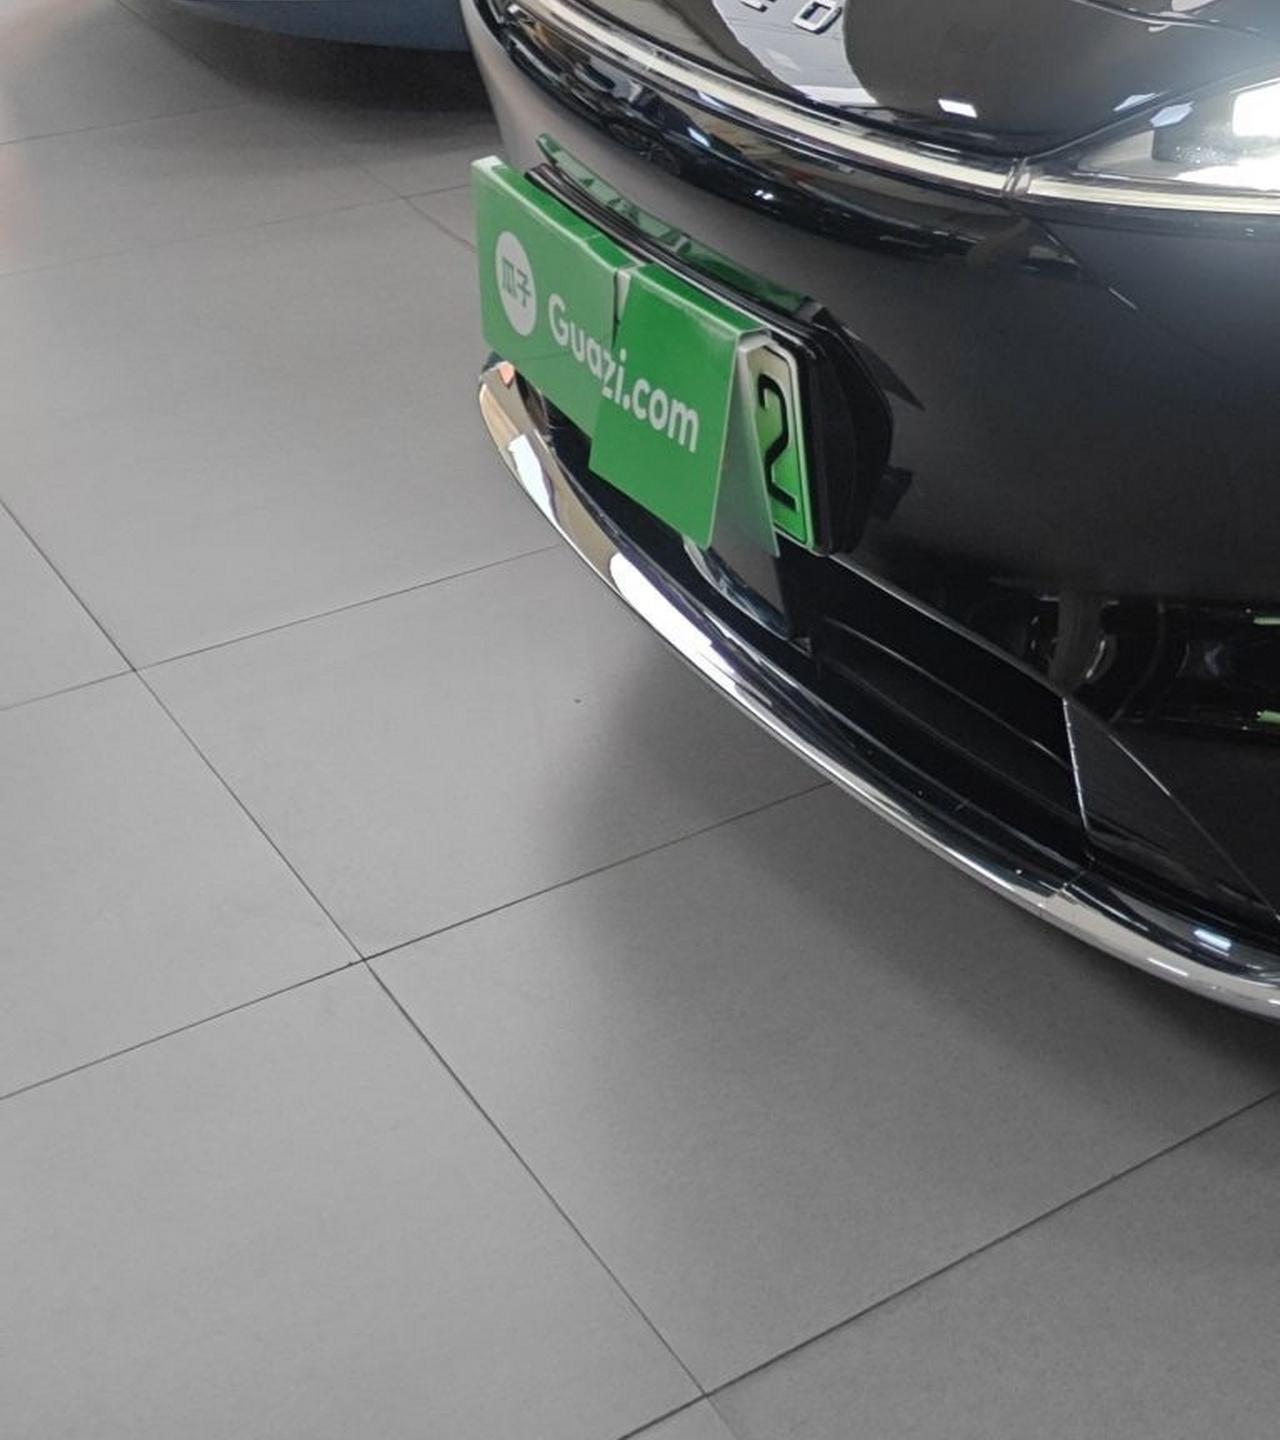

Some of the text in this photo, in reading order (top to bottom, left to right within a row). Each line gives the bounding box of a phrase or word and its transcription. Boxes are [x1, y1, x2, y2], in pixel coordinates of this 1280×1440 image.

[502, 256, 532, 308] 瓜子
[548, 293, 699, 453] Guazi.com
[757, 373, 799, 513] 2
